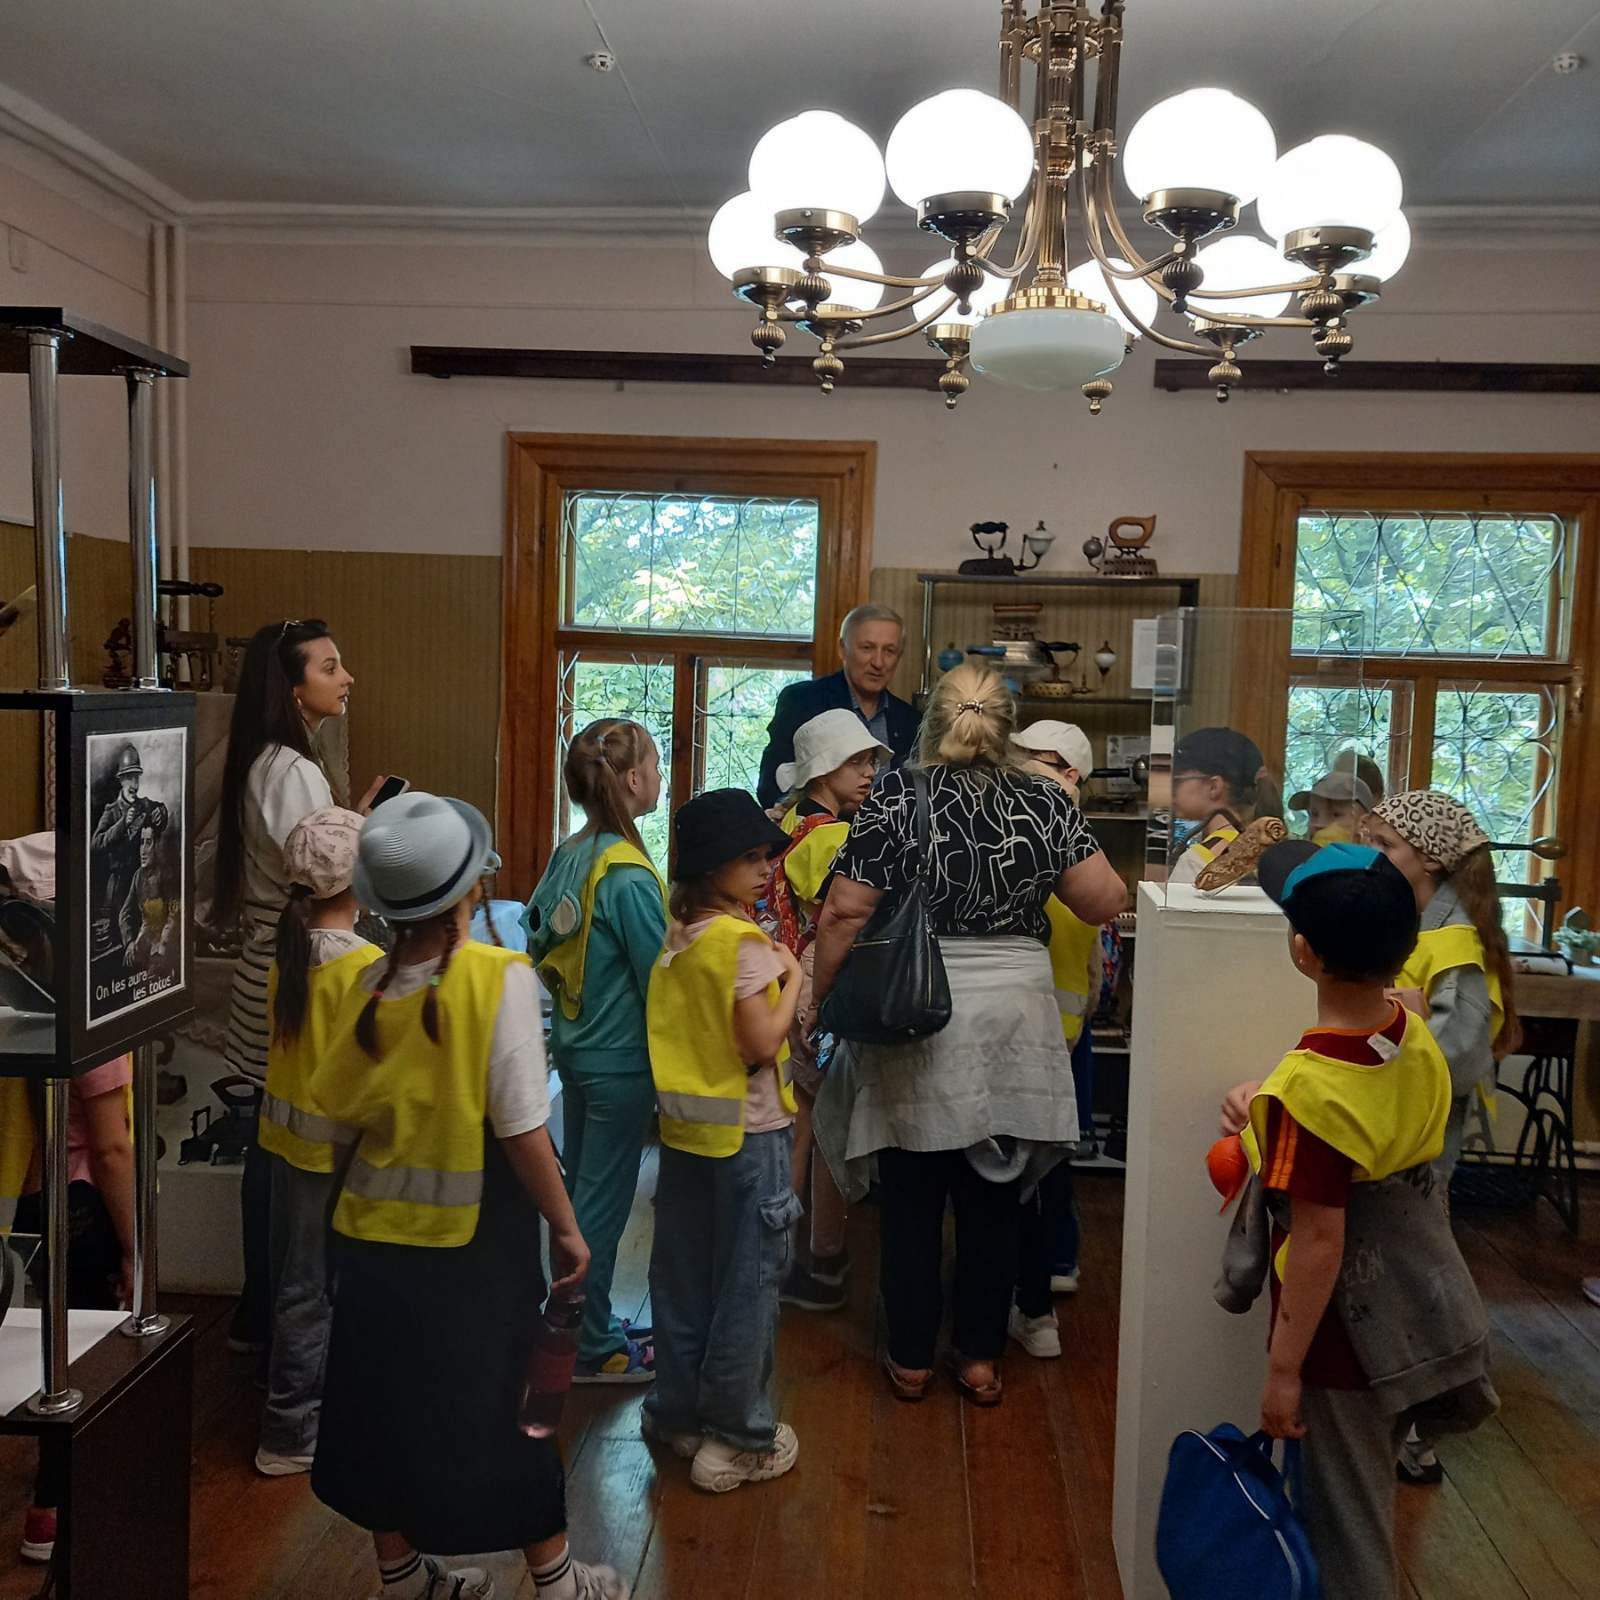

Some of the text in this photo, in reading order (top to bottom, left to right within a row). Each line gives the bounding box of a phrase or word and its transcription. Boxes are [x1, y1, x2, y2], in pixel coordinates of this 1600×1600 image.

[96, 985, 109, 1000] On
[111, 979, 126, 994] les
[133, 987, 146, 1001] les
